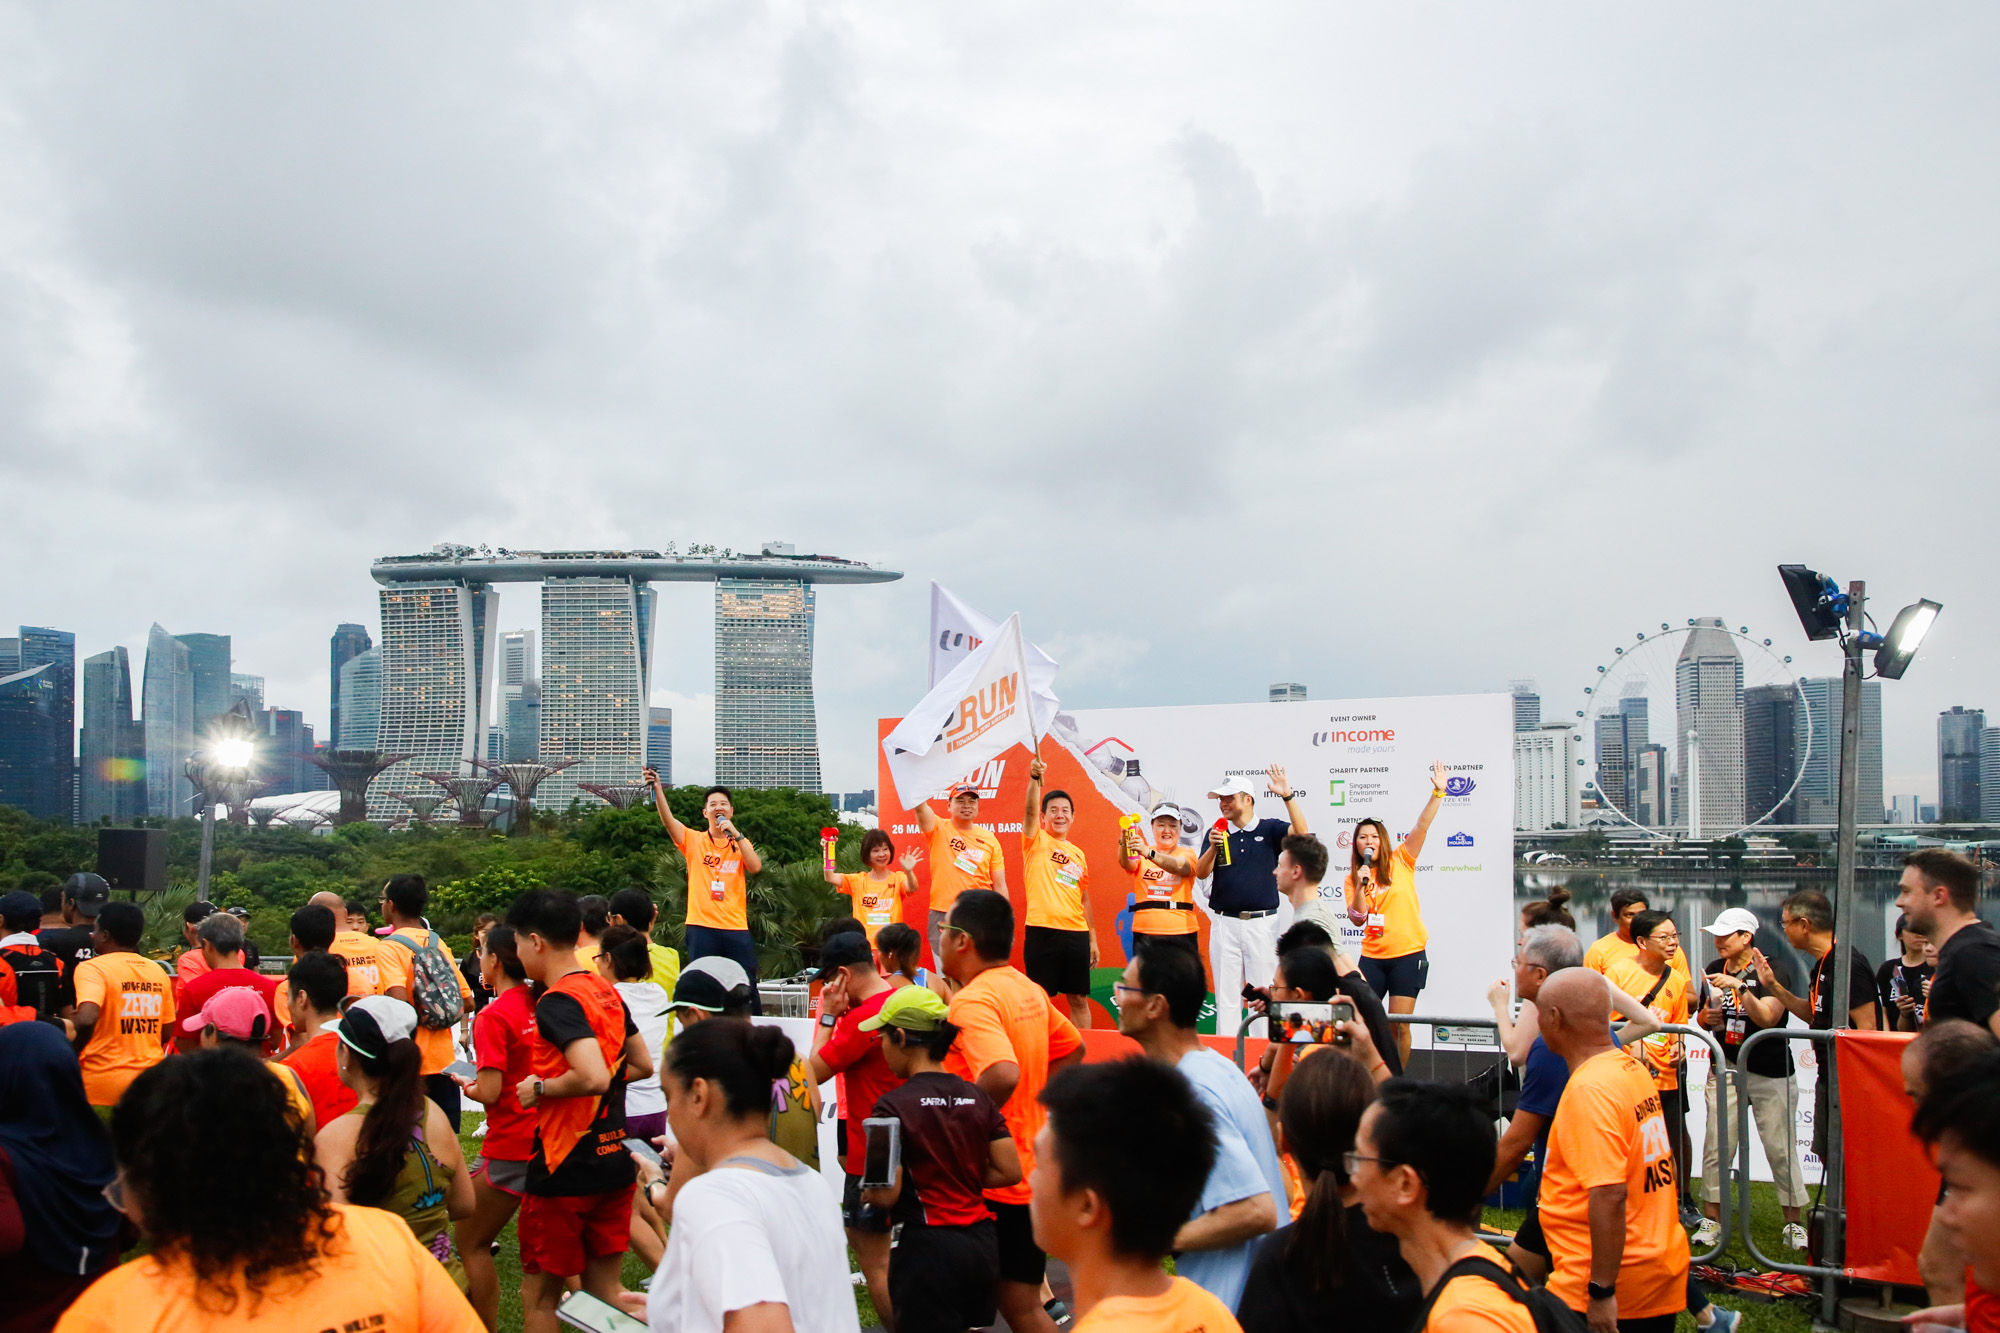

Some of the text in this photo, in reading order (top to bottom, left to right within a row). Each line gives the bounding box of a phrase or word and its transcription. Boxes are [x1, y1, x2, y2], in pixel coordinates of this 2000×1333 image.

[947, 672, 1018, 737] RUN
[1332, 729, 1395, 742] income
[1347, 745, 1395, 754] made yours
[1349, 782, 1381, 790] Singapore
[892, 824, 904, 834] 26
[1440, 864, 1482, 872] anywheel
[862, 896, 878, 905] ECO
[121, 992, 162, 1017] ZERO
[120, 1018, 159, 1034] WASTE
[920, 1097, 947, 1106] SAFRA
